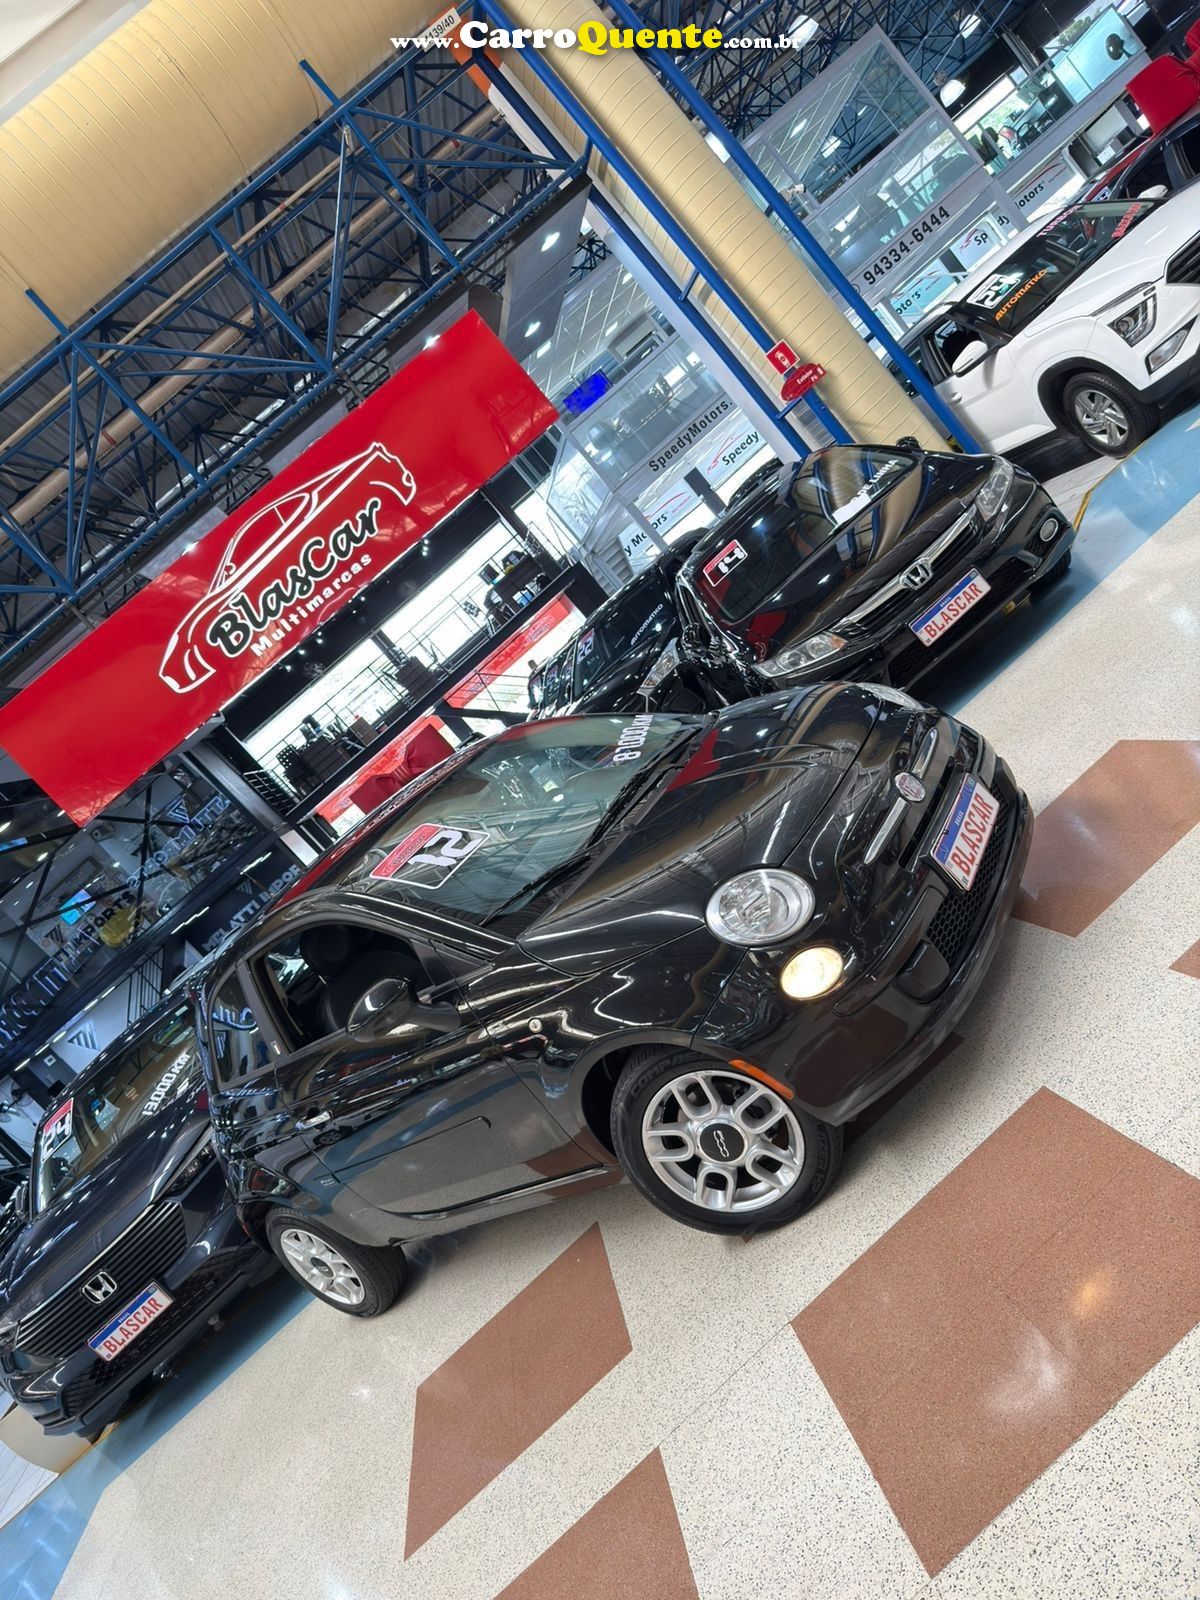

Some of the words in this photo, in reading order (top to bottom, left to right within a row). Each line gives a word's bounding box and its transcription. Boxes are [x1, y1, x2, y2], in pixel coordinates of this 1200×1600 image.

[863, 205, 950, 285] 94334-6444
[722, 431, 759, 466] Speedy
[206, 497, 381, 658] BlasCar
[250, 553, 372, 657] Multimarcas
[924, 582, 982, 639] BLASCAR
[951, 792, 994, 876] BLASCAR
[103, 1297, 163, 1354] BLASCAR
